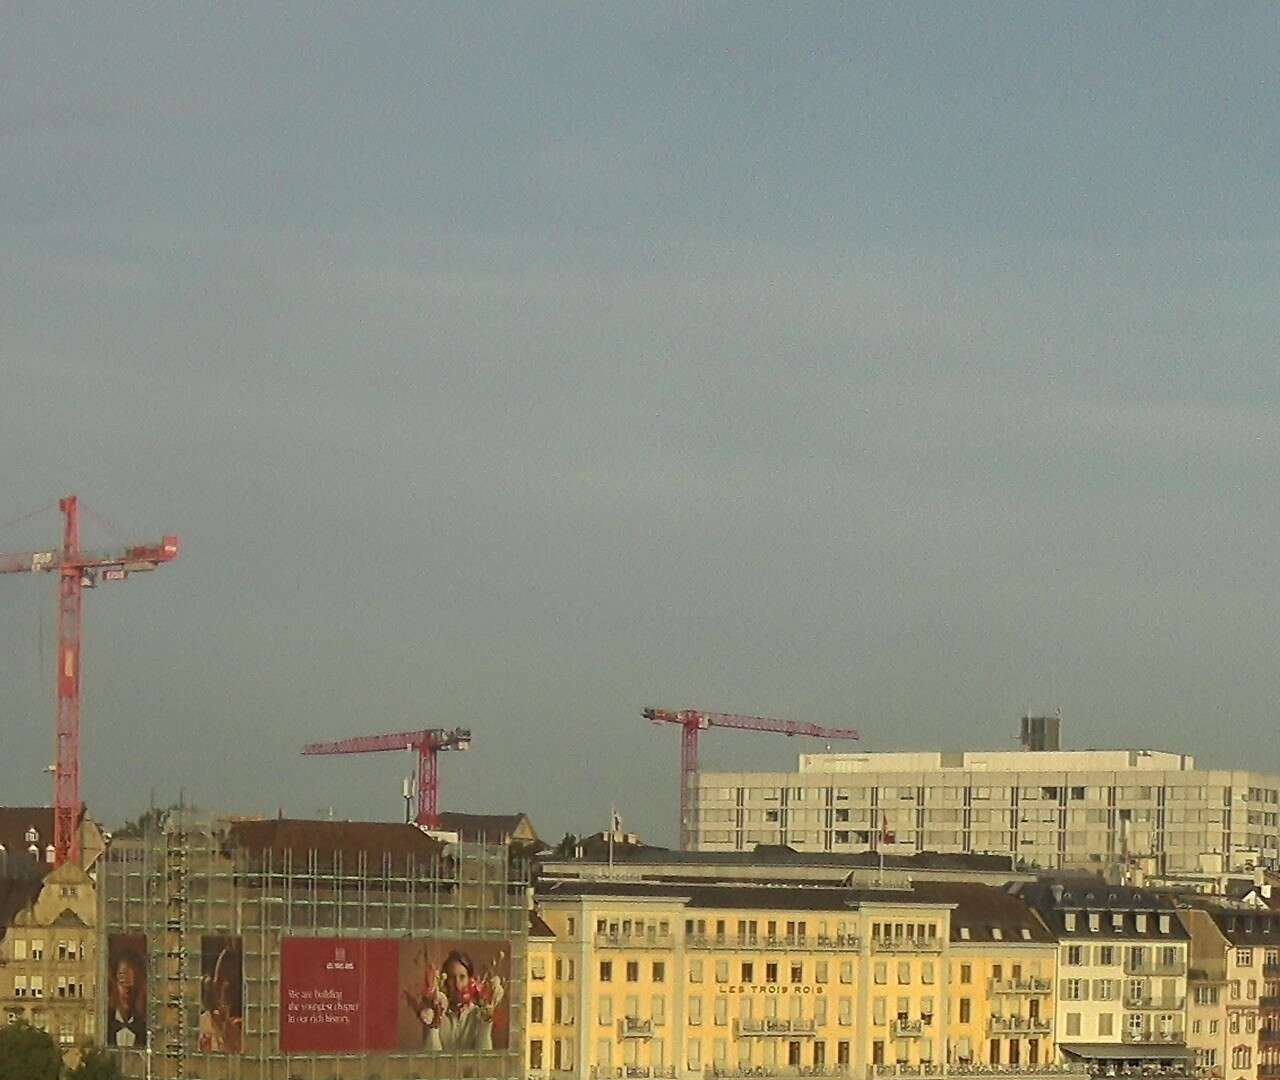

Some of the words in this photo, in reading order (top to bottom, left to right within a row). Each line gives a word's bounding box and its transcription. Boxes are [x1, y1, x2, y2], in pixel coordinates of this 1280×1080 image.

[719, 985, 745, 994] LES
[750, 985, 788, 994] TROIS
[794, 985, 824, 994] ROIS
